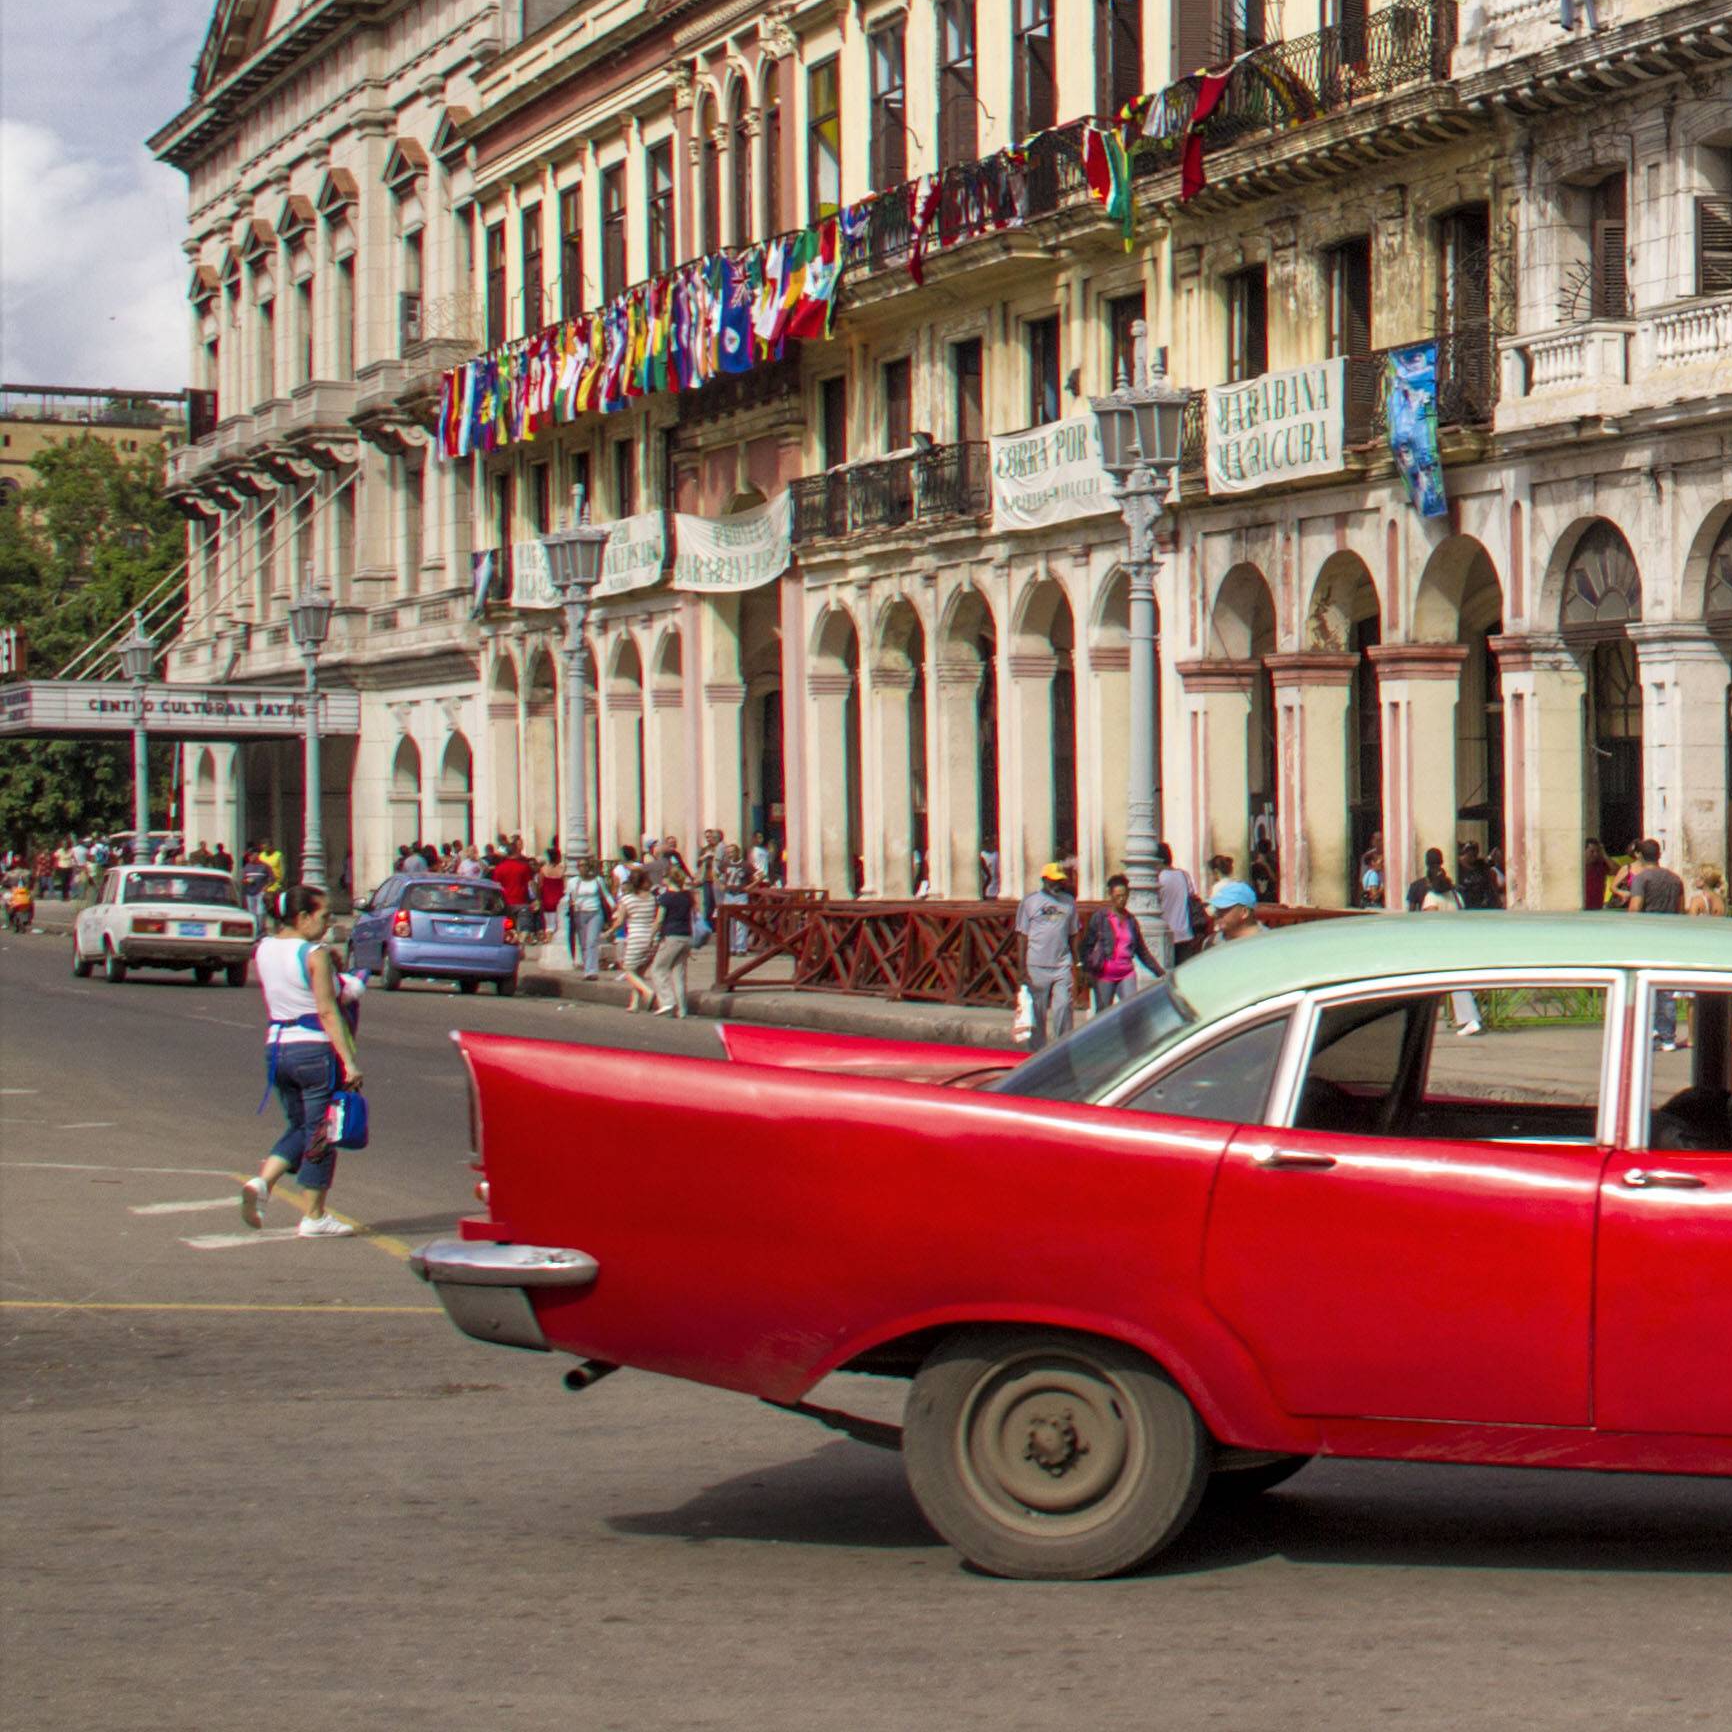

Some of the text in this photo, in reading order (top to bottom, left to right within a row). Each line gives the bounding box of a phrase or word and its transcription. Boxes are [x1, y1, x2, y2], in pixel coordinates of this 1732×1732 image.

[995, 436, 1048, 479] CORRA
[1055, 423, 1088, 467] POR
[161, 699, 249, 717] CULTURAL
[254, 703, 306, 720] PAYRE
